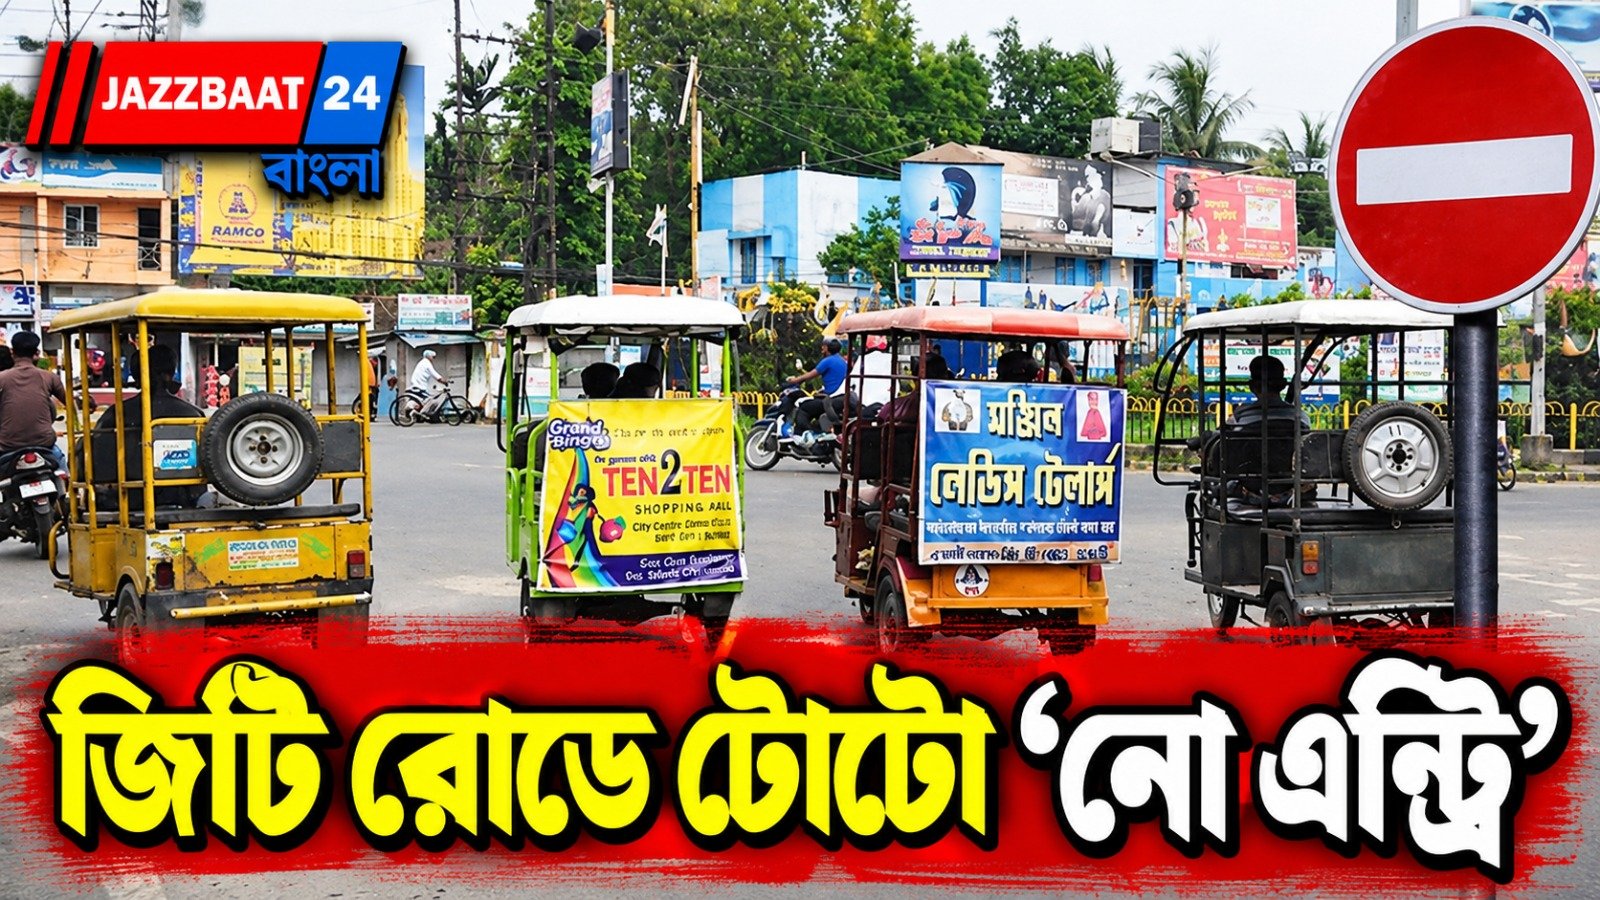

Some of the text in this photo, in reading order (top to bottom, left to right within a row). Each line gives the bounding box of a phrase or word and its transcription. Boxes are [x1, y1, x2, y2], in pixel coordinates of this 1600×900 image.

[212, 226, 265, 238] RAMCO
[550, 419, 603, 436] Grand
[635, 502, 704, 515] SHOPPING
